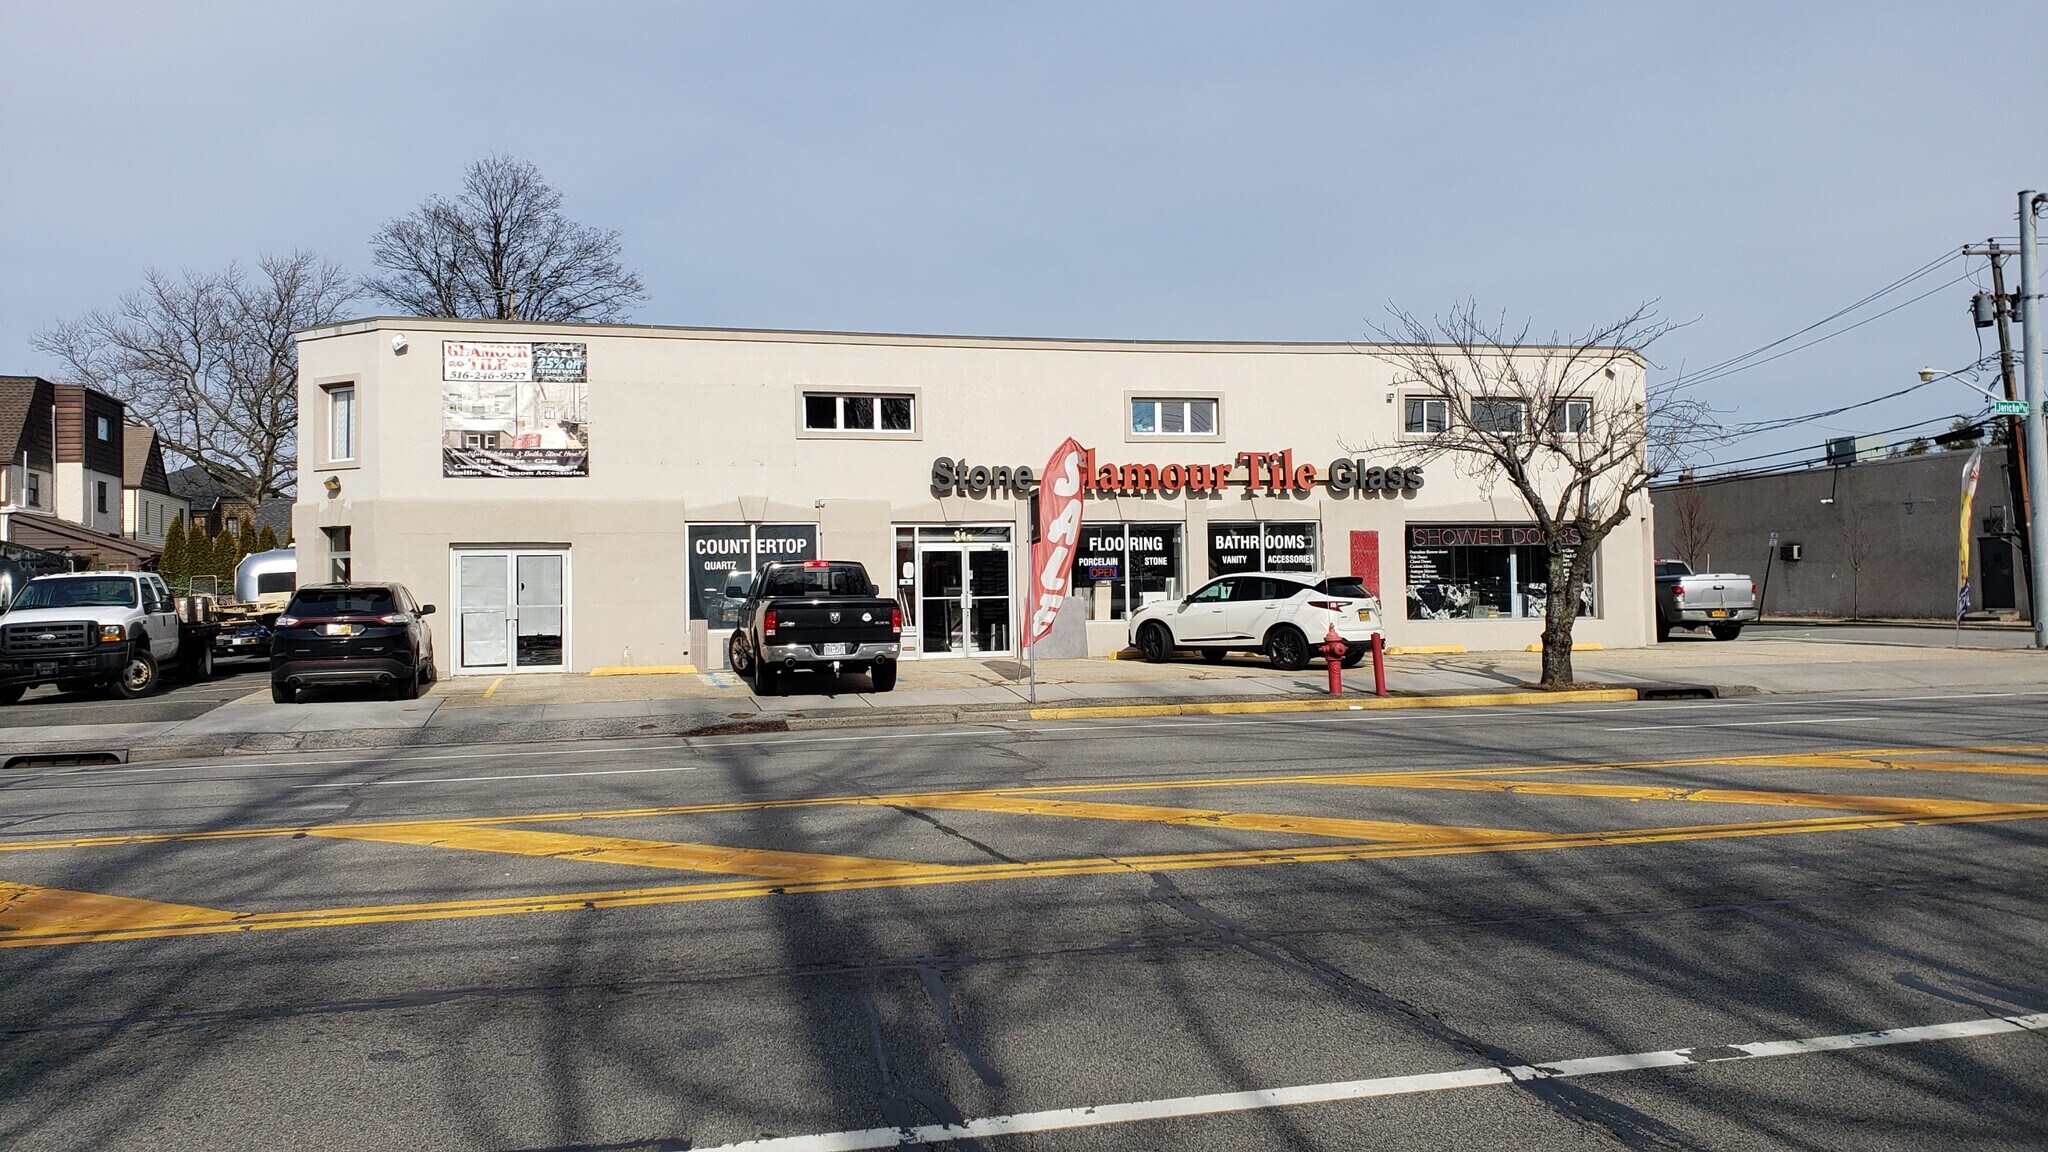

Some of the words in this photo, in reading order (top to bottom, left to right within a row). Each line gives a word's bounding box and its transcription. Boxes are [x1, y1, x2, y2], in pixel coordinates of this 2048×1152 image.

[447, 344, 529, 358] GLAMOUR
[536, 350, 582, 358] SALE
[468, 358, 508, 371] TILE
[537, 358, 565, 370] 25%
[449, 370, 526, 380] 516-246-9522
[1997, 402, 2019, 412] Jericho
[932, 456, 1034, 492] Stone
[1085, 448, 1233, 491] lamour
[1238, 448, 1317, 491] Tile
[1329, 458, 1425, 492] Glass
[1215, 535, 1306, 550] BATHROOMS
[1413, 528, 1503, 546] SHOWER
[695, 538, 808, 555] COUNTERTOP
[1033, 450, 1085, 638] SALE
[1089, 536, 1163, 552] FLOORING
[1078, 557, 1118, 567] PORCELAIN
[1144, 556, 1168, 566] STONE
[1222, 555, 1247, 565] VANITY
[1267, 554, 1314, 565] ACCESSORIES
[704, 561, 737, 571] QUARTZ
[1090, 567, 1116, 579] OPEN
